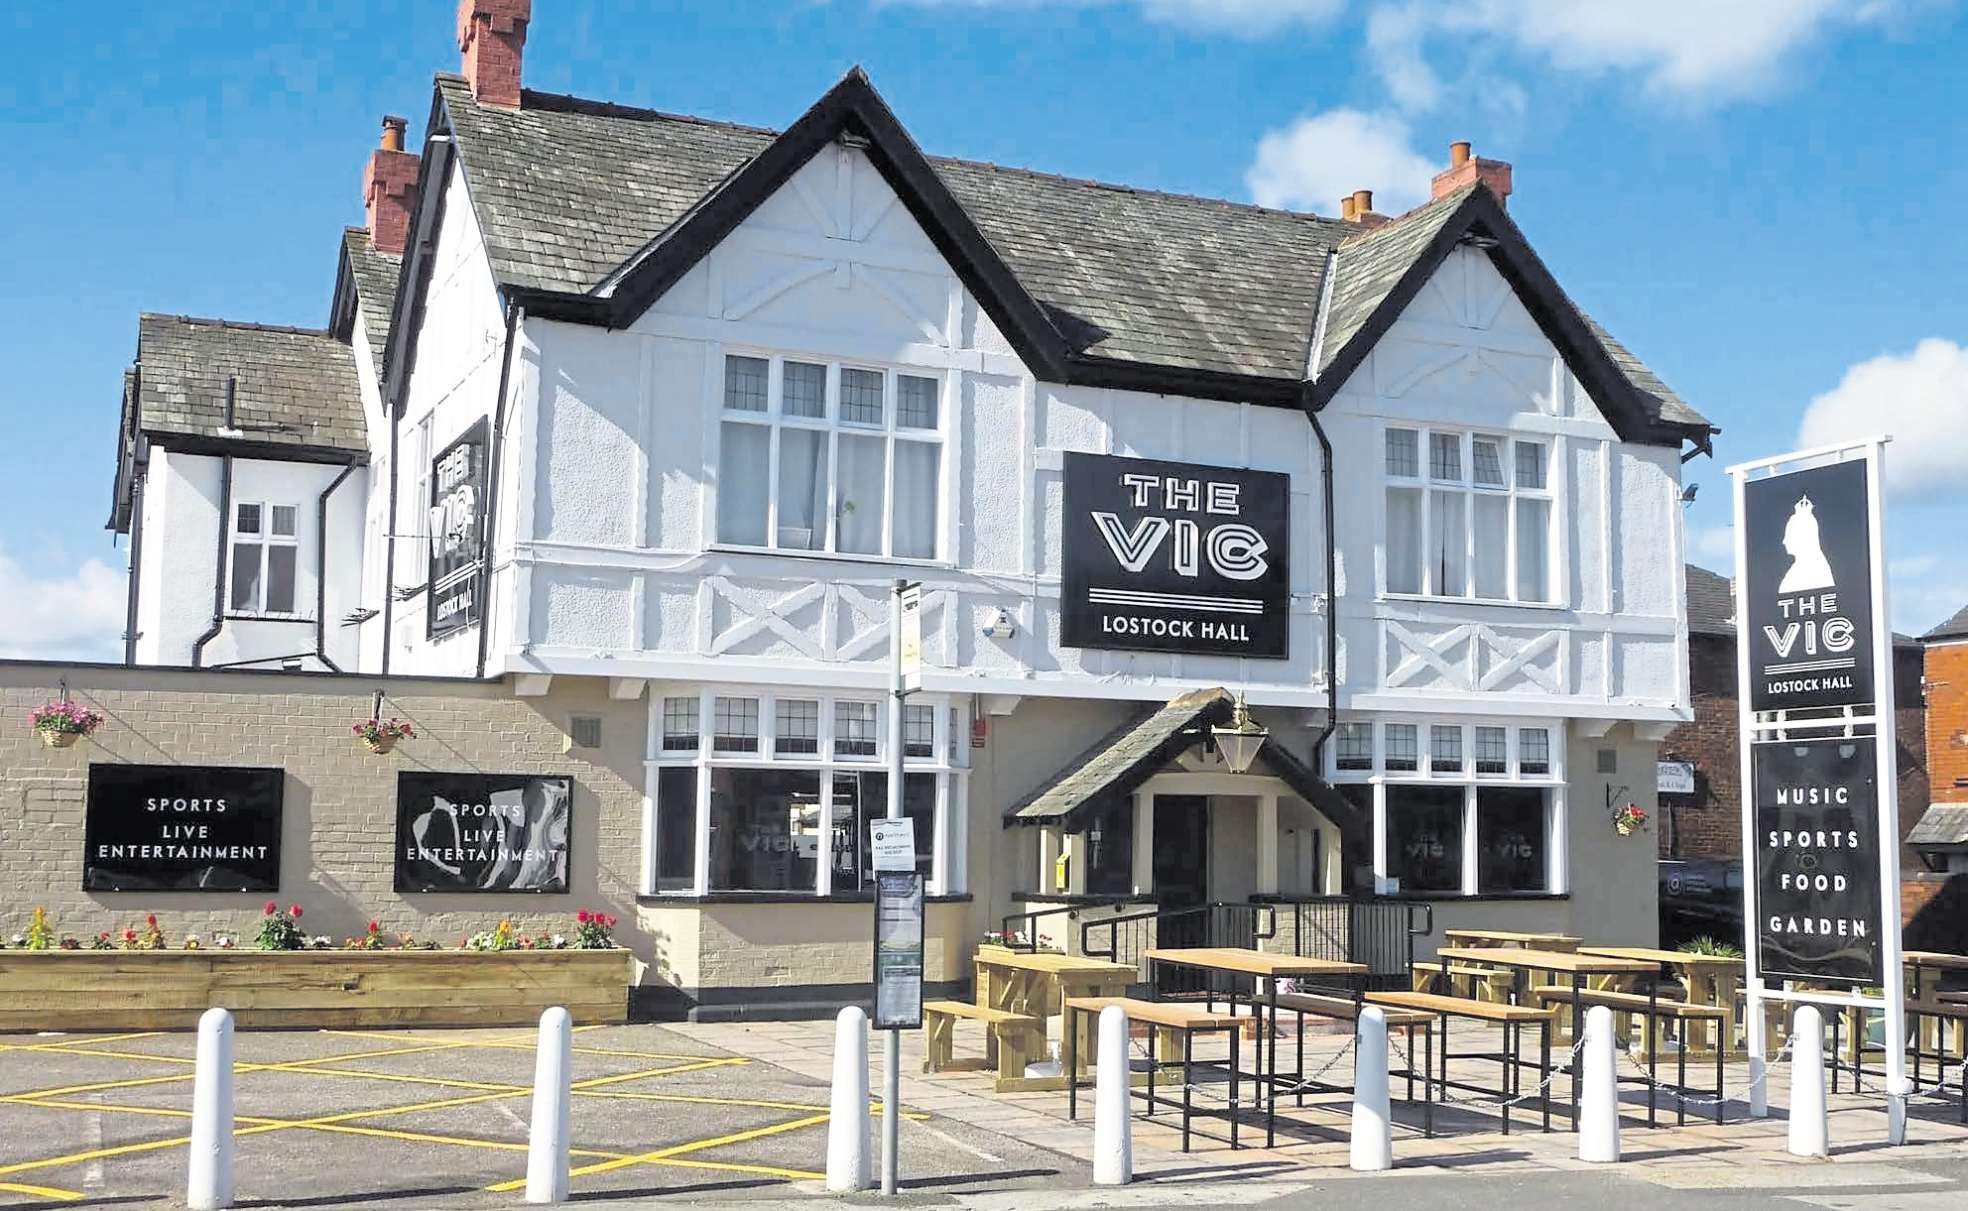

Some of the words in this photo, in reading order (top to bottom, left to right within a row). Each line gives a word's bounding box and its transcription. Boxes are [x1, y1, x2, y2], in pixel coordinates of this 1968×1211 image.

[437, 444, 470, 493] THE
[1123, 473, 1240, 516] THE
[430, 484, 475, 559] VIC
[1090, 511, 1269, 581] VIC
[1777, 593, 1838, 619] THE
[1102, 615, 1194, 638] LOSTOCK
[1201, 622, 1250, 642] HALL
[1763, 617, 1855, 658] VIC
[1768, 678, 1820, 694] LOSTOCK
[1822, 675, 1853, 690] HALL
[147, 798, 227, 812] SPORTS
[1776, 787, 1849, 805] MUSIC
[450, 803, 521, 817] SPORTS
[162, 825, 209, 839] LIVE
[463, 829, 505, 843] LIVE
[1769, 830, 1859, 848] SPORTS
[99, 844, 268, 859] ENTERTAINMENT
[407, 847, 559, 862] ENTERTAINMENT
[1781, 873, 1847, 892] FOOD
[1769, 915, 1866, 937] GARDEN
